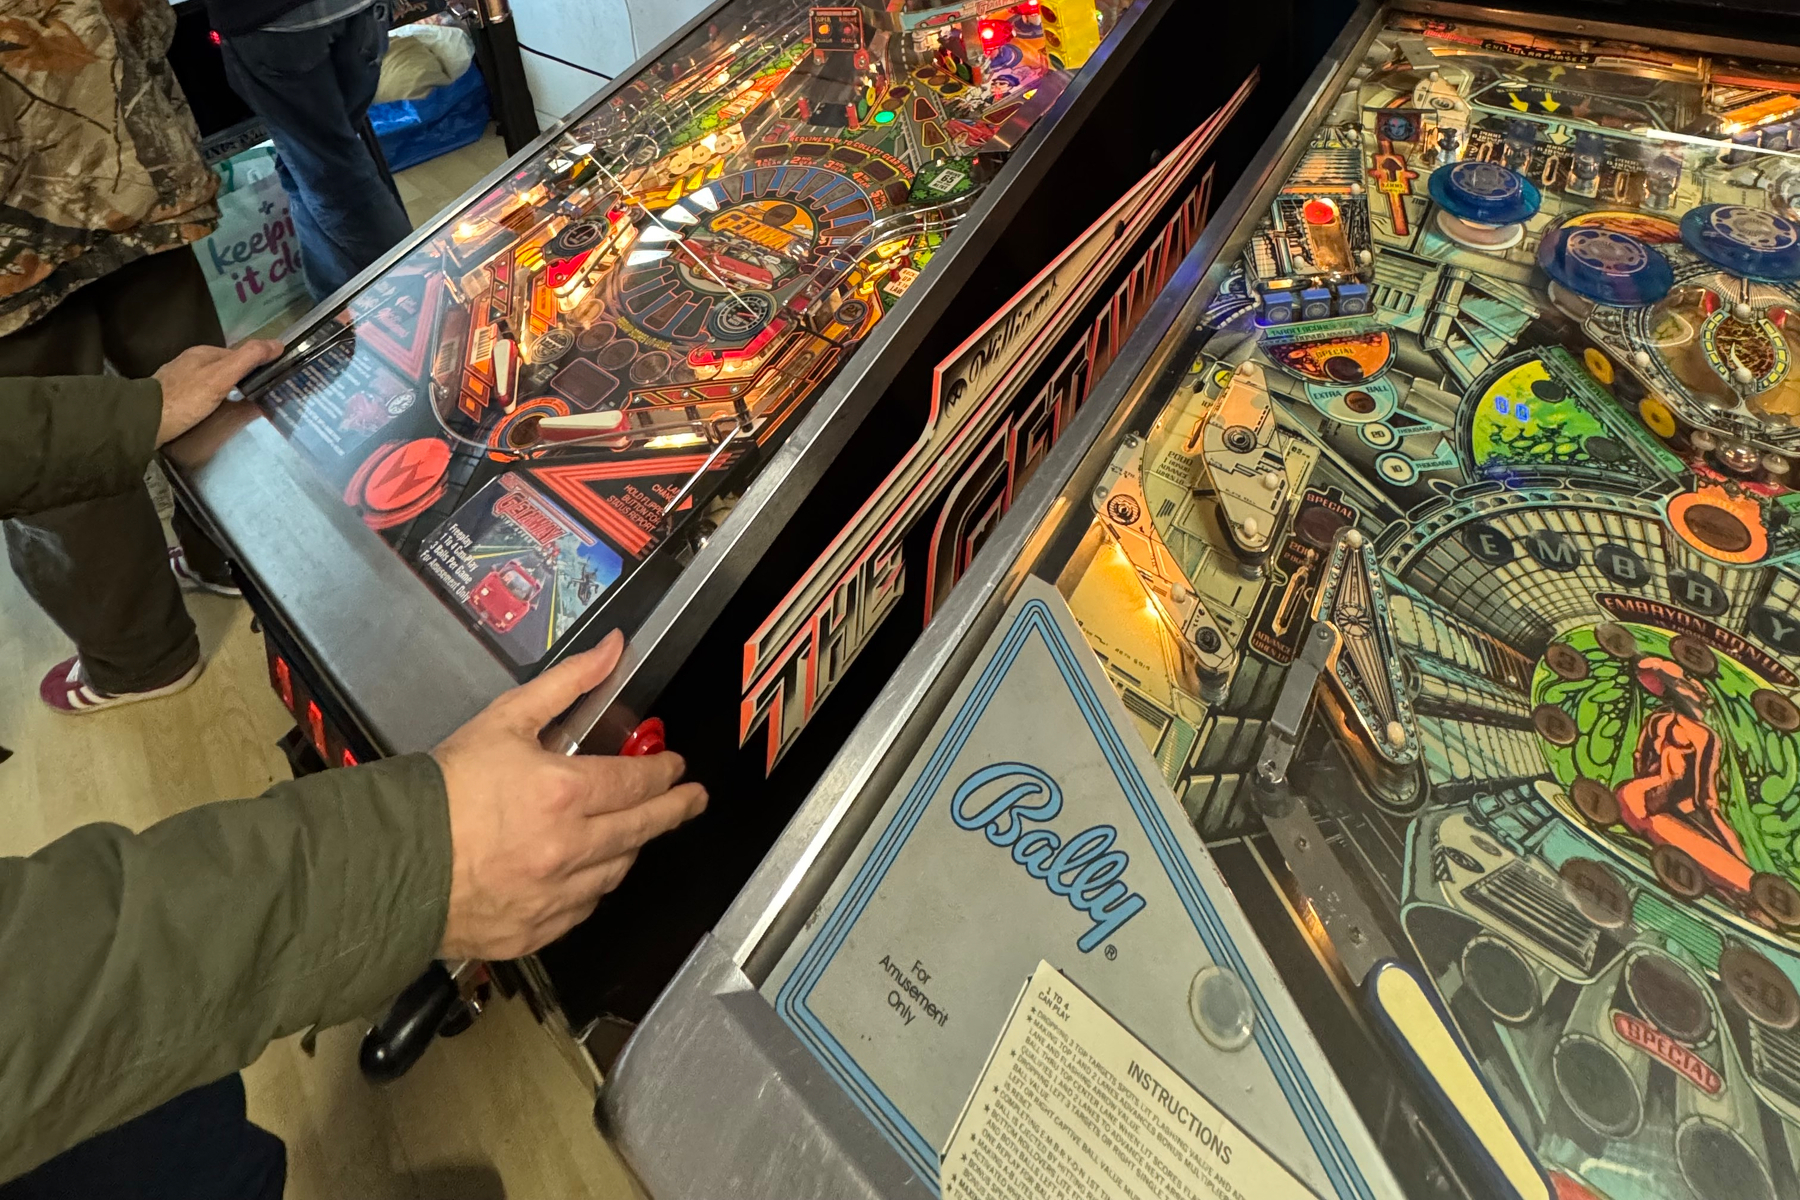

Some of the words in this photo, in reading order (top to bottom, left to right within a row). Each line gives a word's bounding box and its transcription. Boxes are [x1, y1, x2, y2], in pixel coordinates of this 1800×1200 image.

[853, 141, 884, 155] COLLECT
[881, 152, 901, 166] GEAR
[896, 161, 915, 180] VALUE
[941, 174, 955, 185] 65
[207, 207, 295, 275] keepi
[231, 265, 265, 304] it
[1315, 347, 1355, 358] SPECIAL
[1313, 390, 1343, 400] EXTRA
[1365, 385, 1389, 394] BALL
[1158, 462, 1189, 480] ADVANCE
[620, 493, 648, 516] BUTTON
[623, 483, 645, 501] HOLD
[1305, 492, 1355, 520] SPECIAL
[491, 491, 568, 547] GETAWAY
[606, 494, 632, 514] STATUS
[627, 510, 657, 533] REPORT
[448, 523, 473, 548] Freeplay
[419, 549, 431, 562] For
[428, 557, 460, 592] Amusement
[455, 582, 472, 605] Only
[446, 554, 458, 570] Per
[454, 566, 474, 584] Game
[1479, 533, 1499, 556] E
[1535, 539, 1573, 564] M
[1612, 554, 1637, 579] B
[1686, 580, 1713, 607] R
[1770, 617, 1795, 642] Y
[739, 539, 907, 780] THE
[1255, 630, 1293, 655] ADVANCE
[1604, 597, 1708, 633] EMBRYON
[1714, 628, 1795, 683] BONUS
[951, 761, 1146, 954] Bally
[879, 954, 952, 1030] Amusement
[911, 959, 932, 986] For
[886, 990, 917, 1027] Only
[1037, 989, 1053, 1008] CAN
[1051, 1002, 1070, 1023] PLAY
[1046, 985, 1051, 995] 1
[1052, 991, 1063, 1005] TO
[1062, 1001, 1070, 1012] 4
[1028, 1025, 1046, 1046] LANE
[1045, 1041, 1060, 1059] AND
[1059, 1054, 1092, 1089] FLASHING
[1091, 1084, 1116, 1111] ARROW
[1627, 1021, 1718, 1089] SPECIAL
[1032, 1017, 1058, 1045] MAKING
[1058, 1041, 1072, 1058] TOP
[1076, 1057, 1091, 1076] AND
[1096, 1076, 1119, 1101] LANES
[1118, 1096, 1157, 1136] ADVANCES
[1155, 1131, 1184, 1162] BONUS
[1024, 1035, 1041, 1054] BALL
[1040, 1050, 1059, 1070] THRU
[1059, 1067, 1073, 1084] TOP
[1071, 1079, 1100, 1109] CENTER
[1098, 1104, 1118, 1126] LANE
[1116, 1121, 1140, 1147] WHEN
[1139, 1143, 1153, 1159] LIT
[1152, 1154, 1183, 1188] SCORES
[1074, 1043, 1088, 1060] TOP
[1086, 1054, 1117, 1086] TARGETS
[1116, 1081, 1140, 1108] SPOTS
[1187, 1148, 1214, 1176] VALUE
[1213, 1172, 1232, 1193] AND
[1126, 1059, 1234, 1166] INSTRUCTIONS
